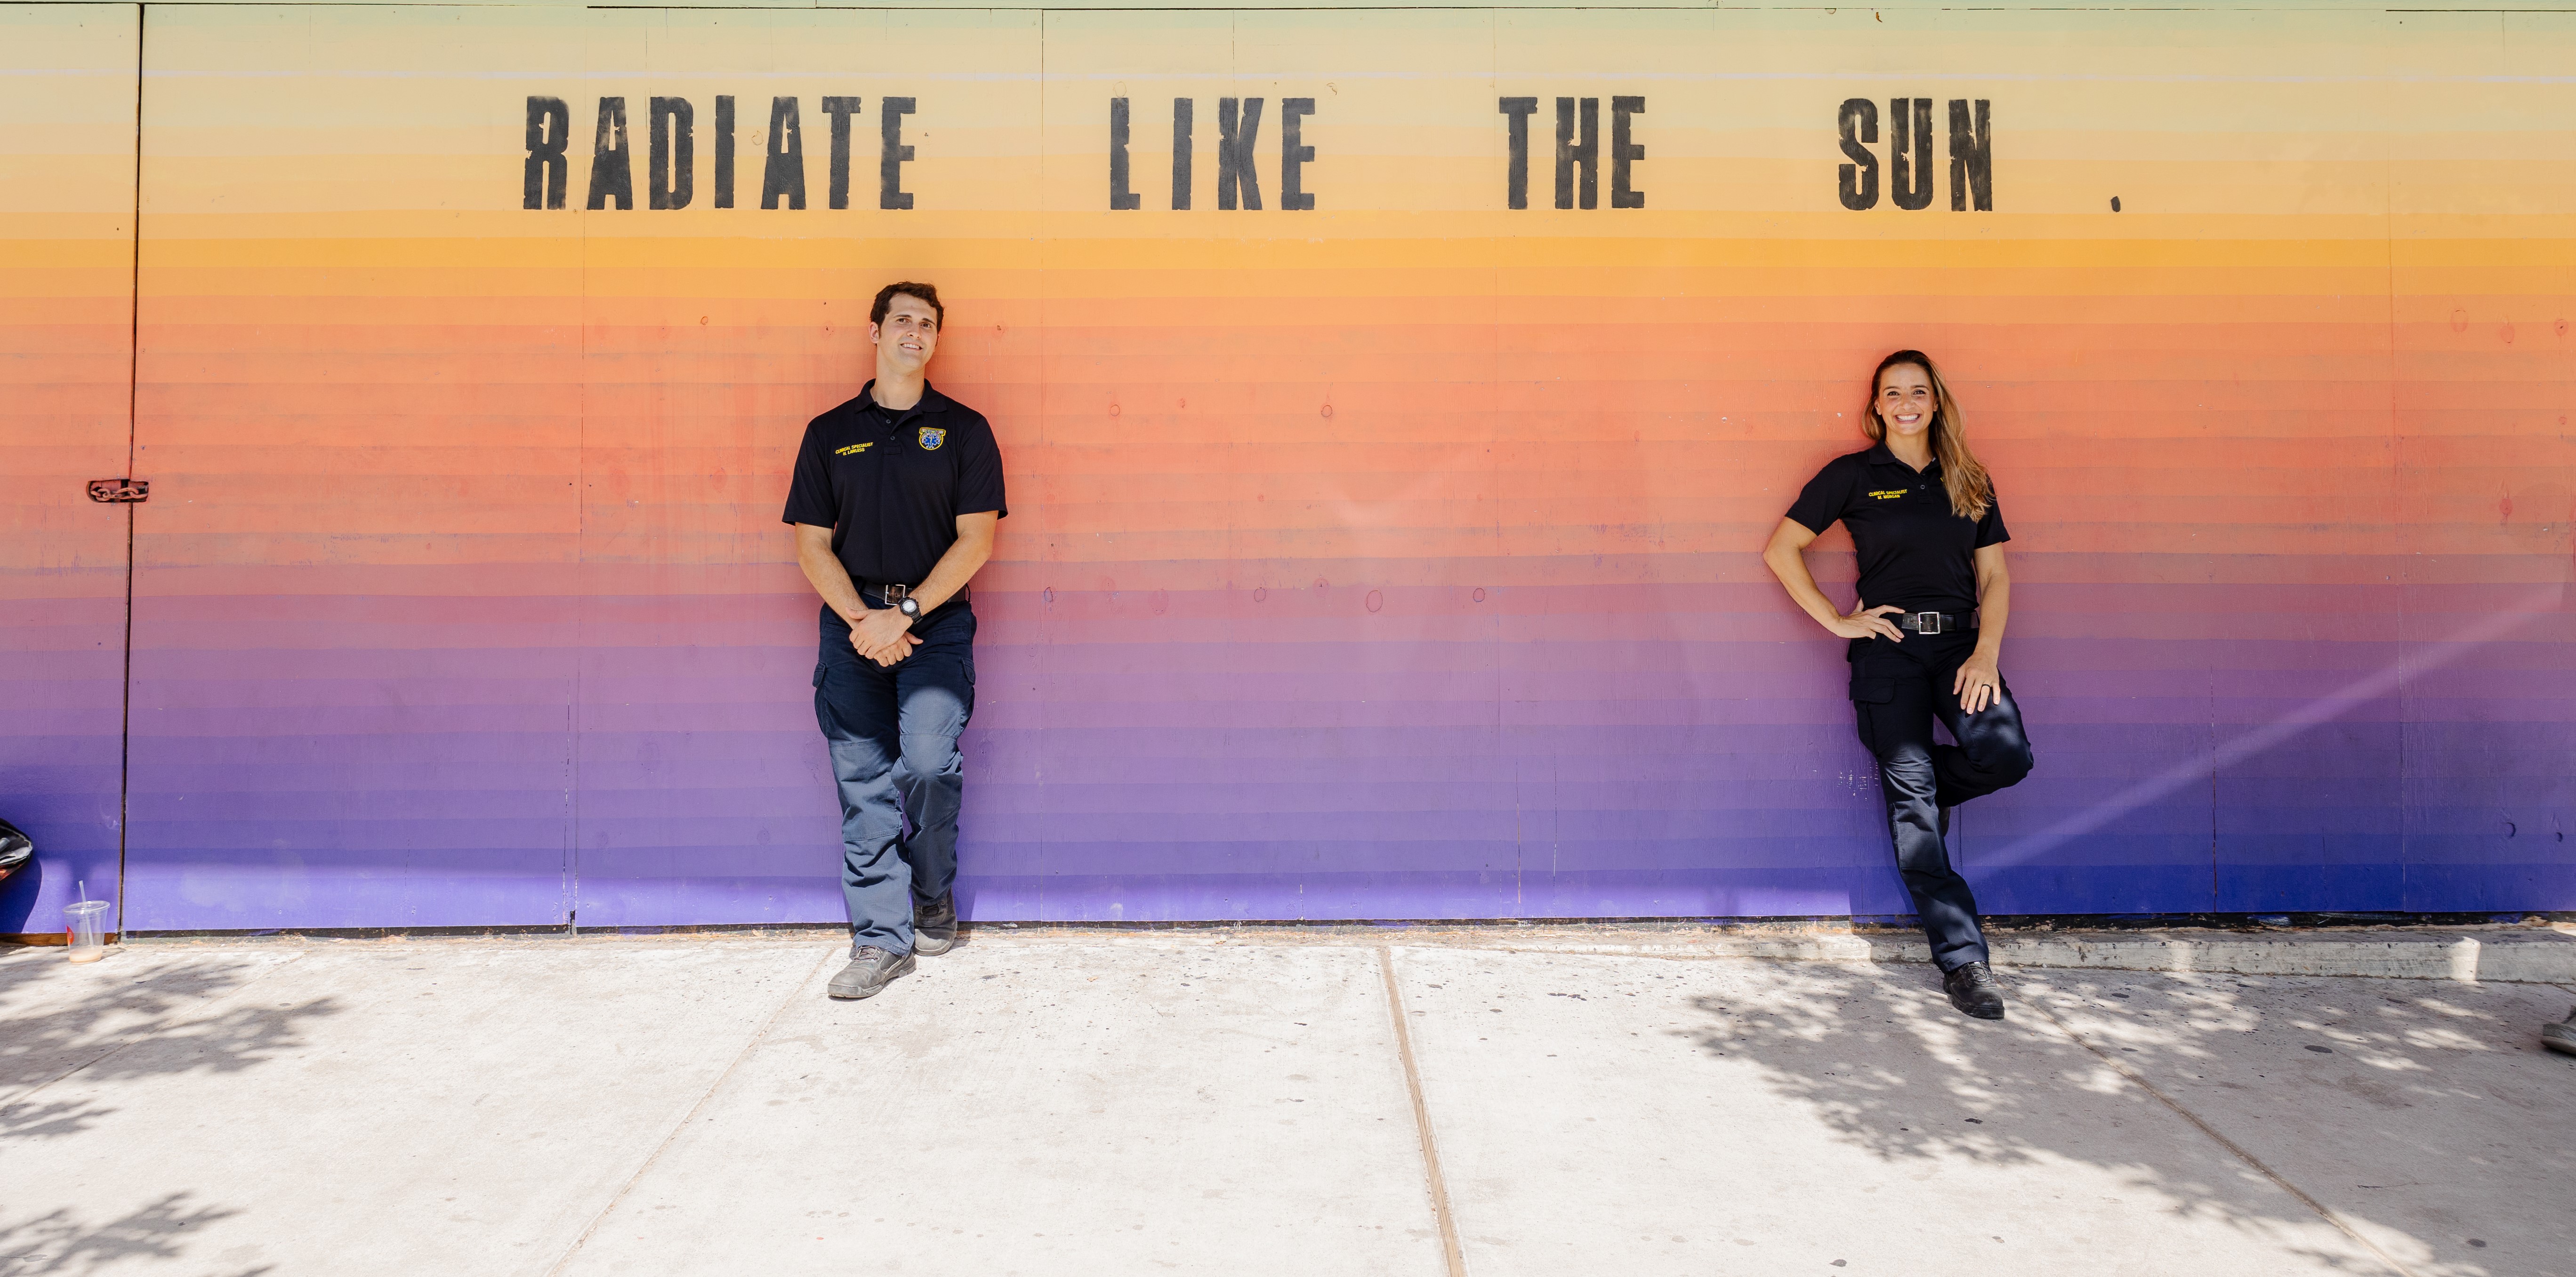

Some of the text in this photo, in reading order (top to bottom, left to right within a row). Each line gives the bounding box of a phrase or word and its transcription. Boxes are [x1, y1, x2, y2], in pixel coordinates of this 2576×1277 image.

[523, 95, 916, 210] RADIATE
[1110, 97, 1315, 210] LIKE
[1499, 96, 1645, 210] THE
[835, 446, 851, 454] CLINICAL
